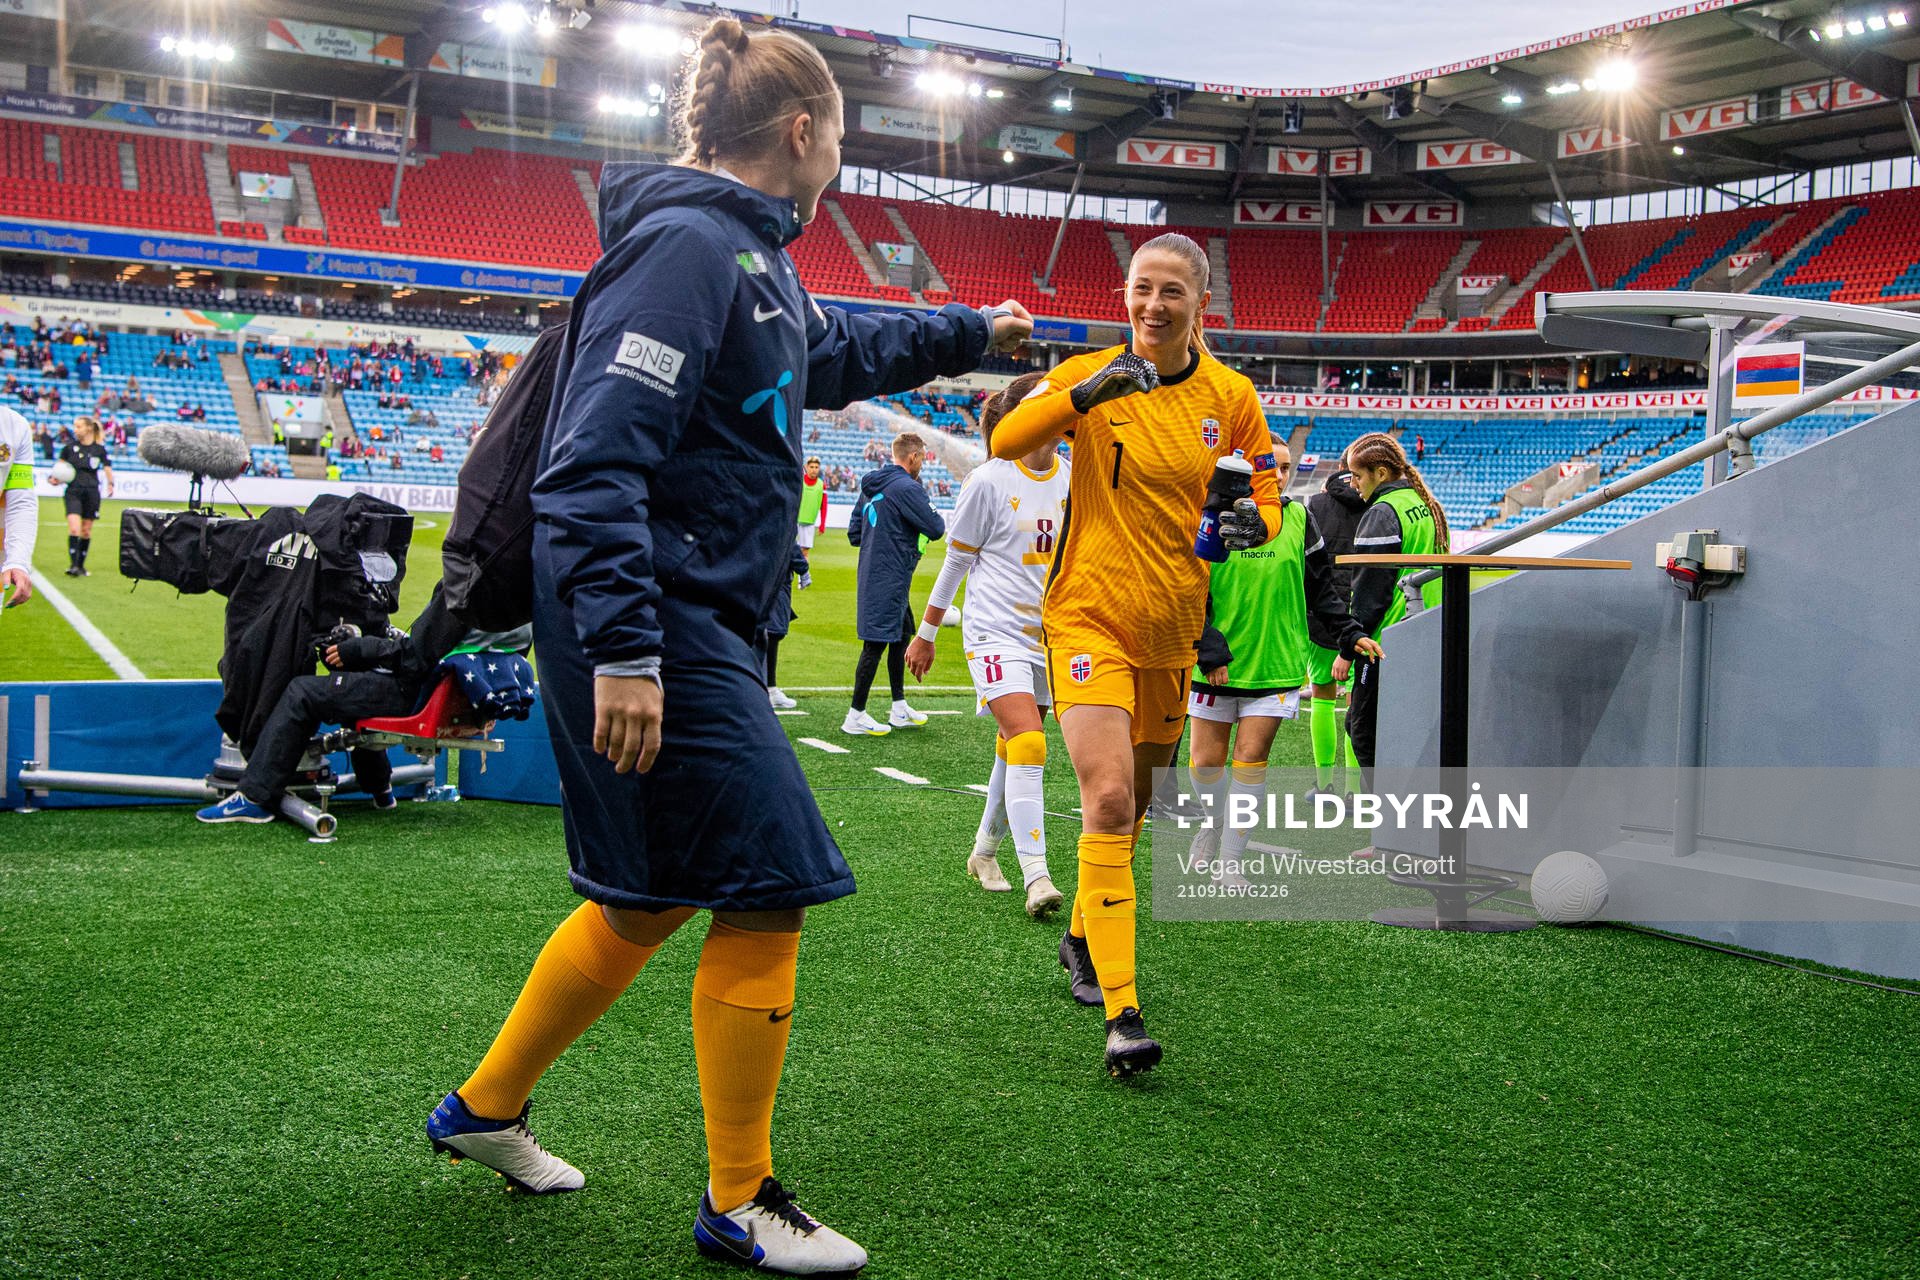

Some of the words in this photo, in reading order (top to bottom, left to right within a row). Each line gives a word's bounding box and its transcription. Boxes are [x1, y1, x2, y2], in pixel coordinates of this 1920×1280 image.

[1671, 104, 1747, 134] VG
[1131, 143, 1212, 166] VG
[1429, 143, 1506, 166] VG
[1242, 203, 1322, 222] VG
[1371, 204, 1452, 223] VG
[626, 338, 675, 374] DNB
[1258, 394, 1296, 406] VG
[1305, 396, 1349, 408] VG
[1358, 397, 1402, 409] VG
[1410, 398, 1452, 410] VG
[1460, 398, 1499, 410] VG
[1506, 397, 1544, 410] VG
[1551, 396, 1586, 409] VG
[1592, 394, 1628, 408] VG
[1636, 393, 1674, 407] VG
[1112, 441, 1123, 489] 1
[1036, 519, 1053, 553] 8
[1241, 550, 1275, 559] macron
